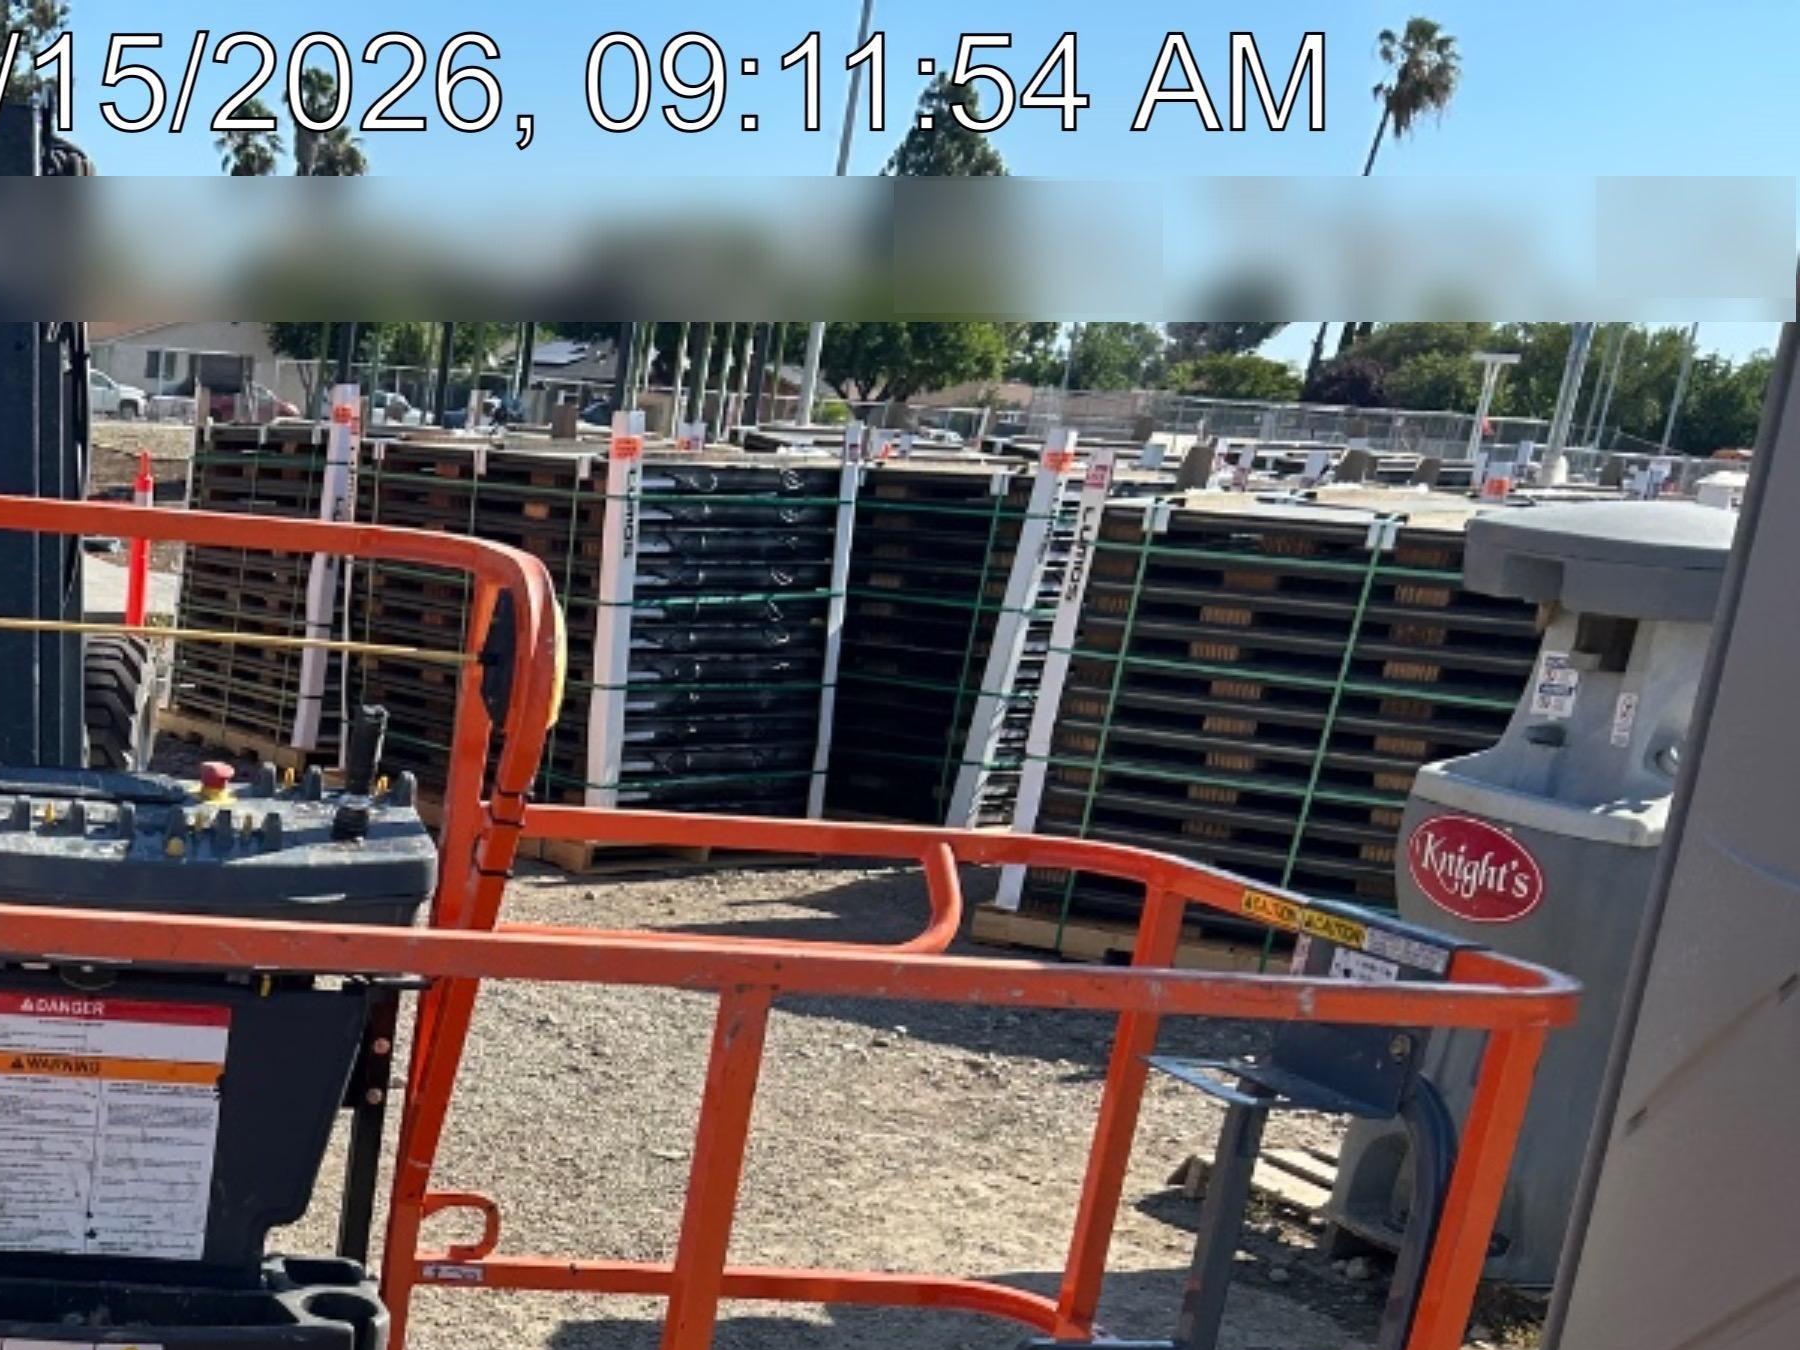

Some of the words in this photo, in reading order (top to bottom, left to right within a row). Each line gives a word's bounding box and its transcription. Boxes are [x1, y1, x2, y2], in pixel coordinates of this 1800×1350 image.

[1417, 832, 1531, 898] Knight's
[35, 998, 105, 1015] DANGER
[26, 1057, 100, 1074] WARNING
